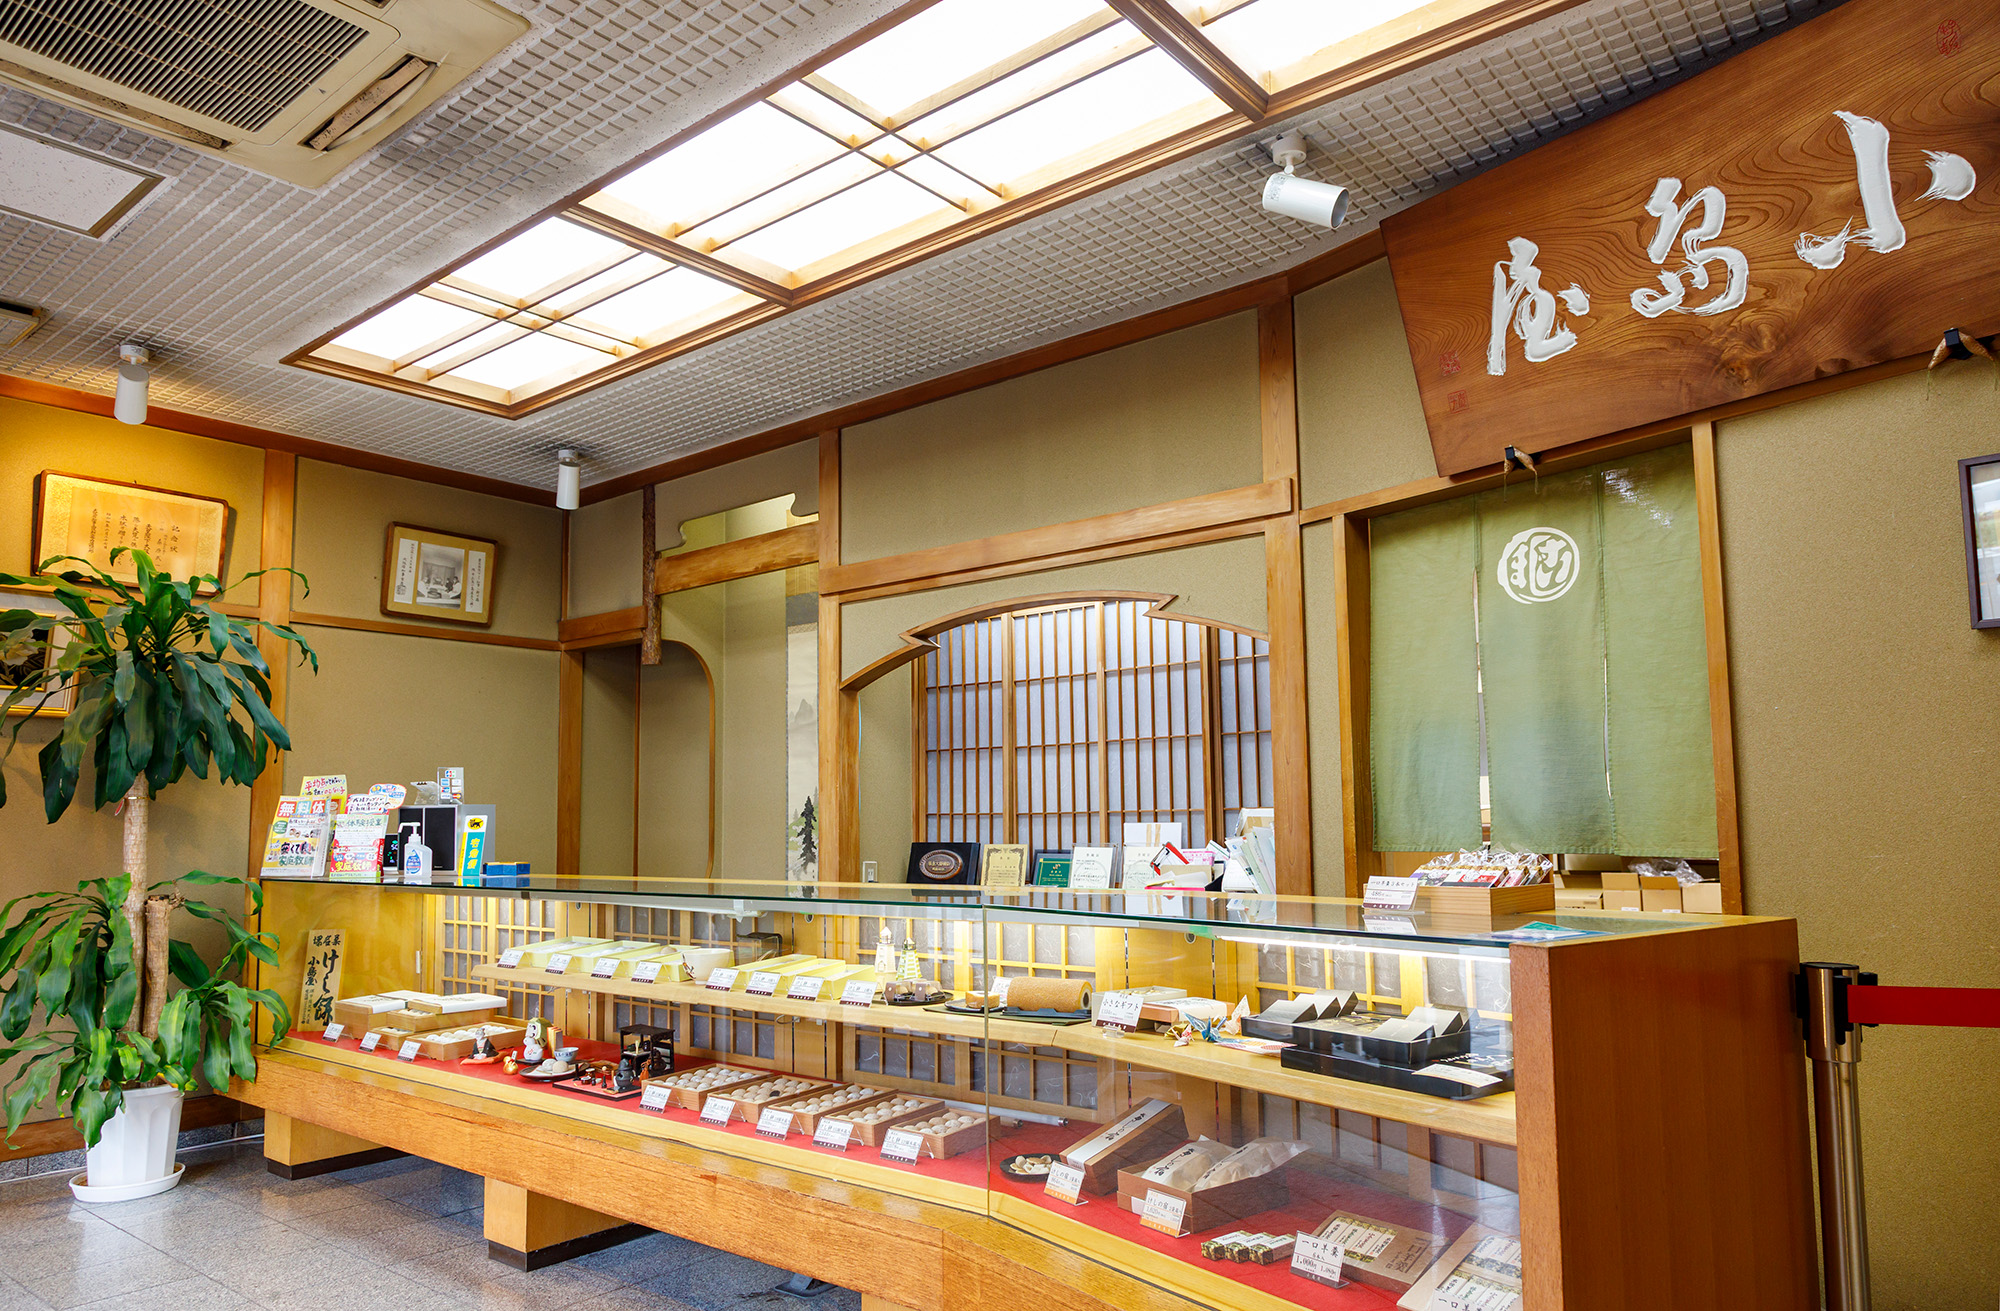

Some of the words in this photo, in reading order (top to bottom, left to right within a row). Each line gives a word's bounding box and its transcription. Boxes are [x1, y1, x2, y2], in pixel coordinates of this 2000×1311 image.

[467, 838, 481, 870] 宅急便
[1301, 1240, 1340, 1258] 一口羊羹
[1438, 1298, 1483, 1311] 一口羊
